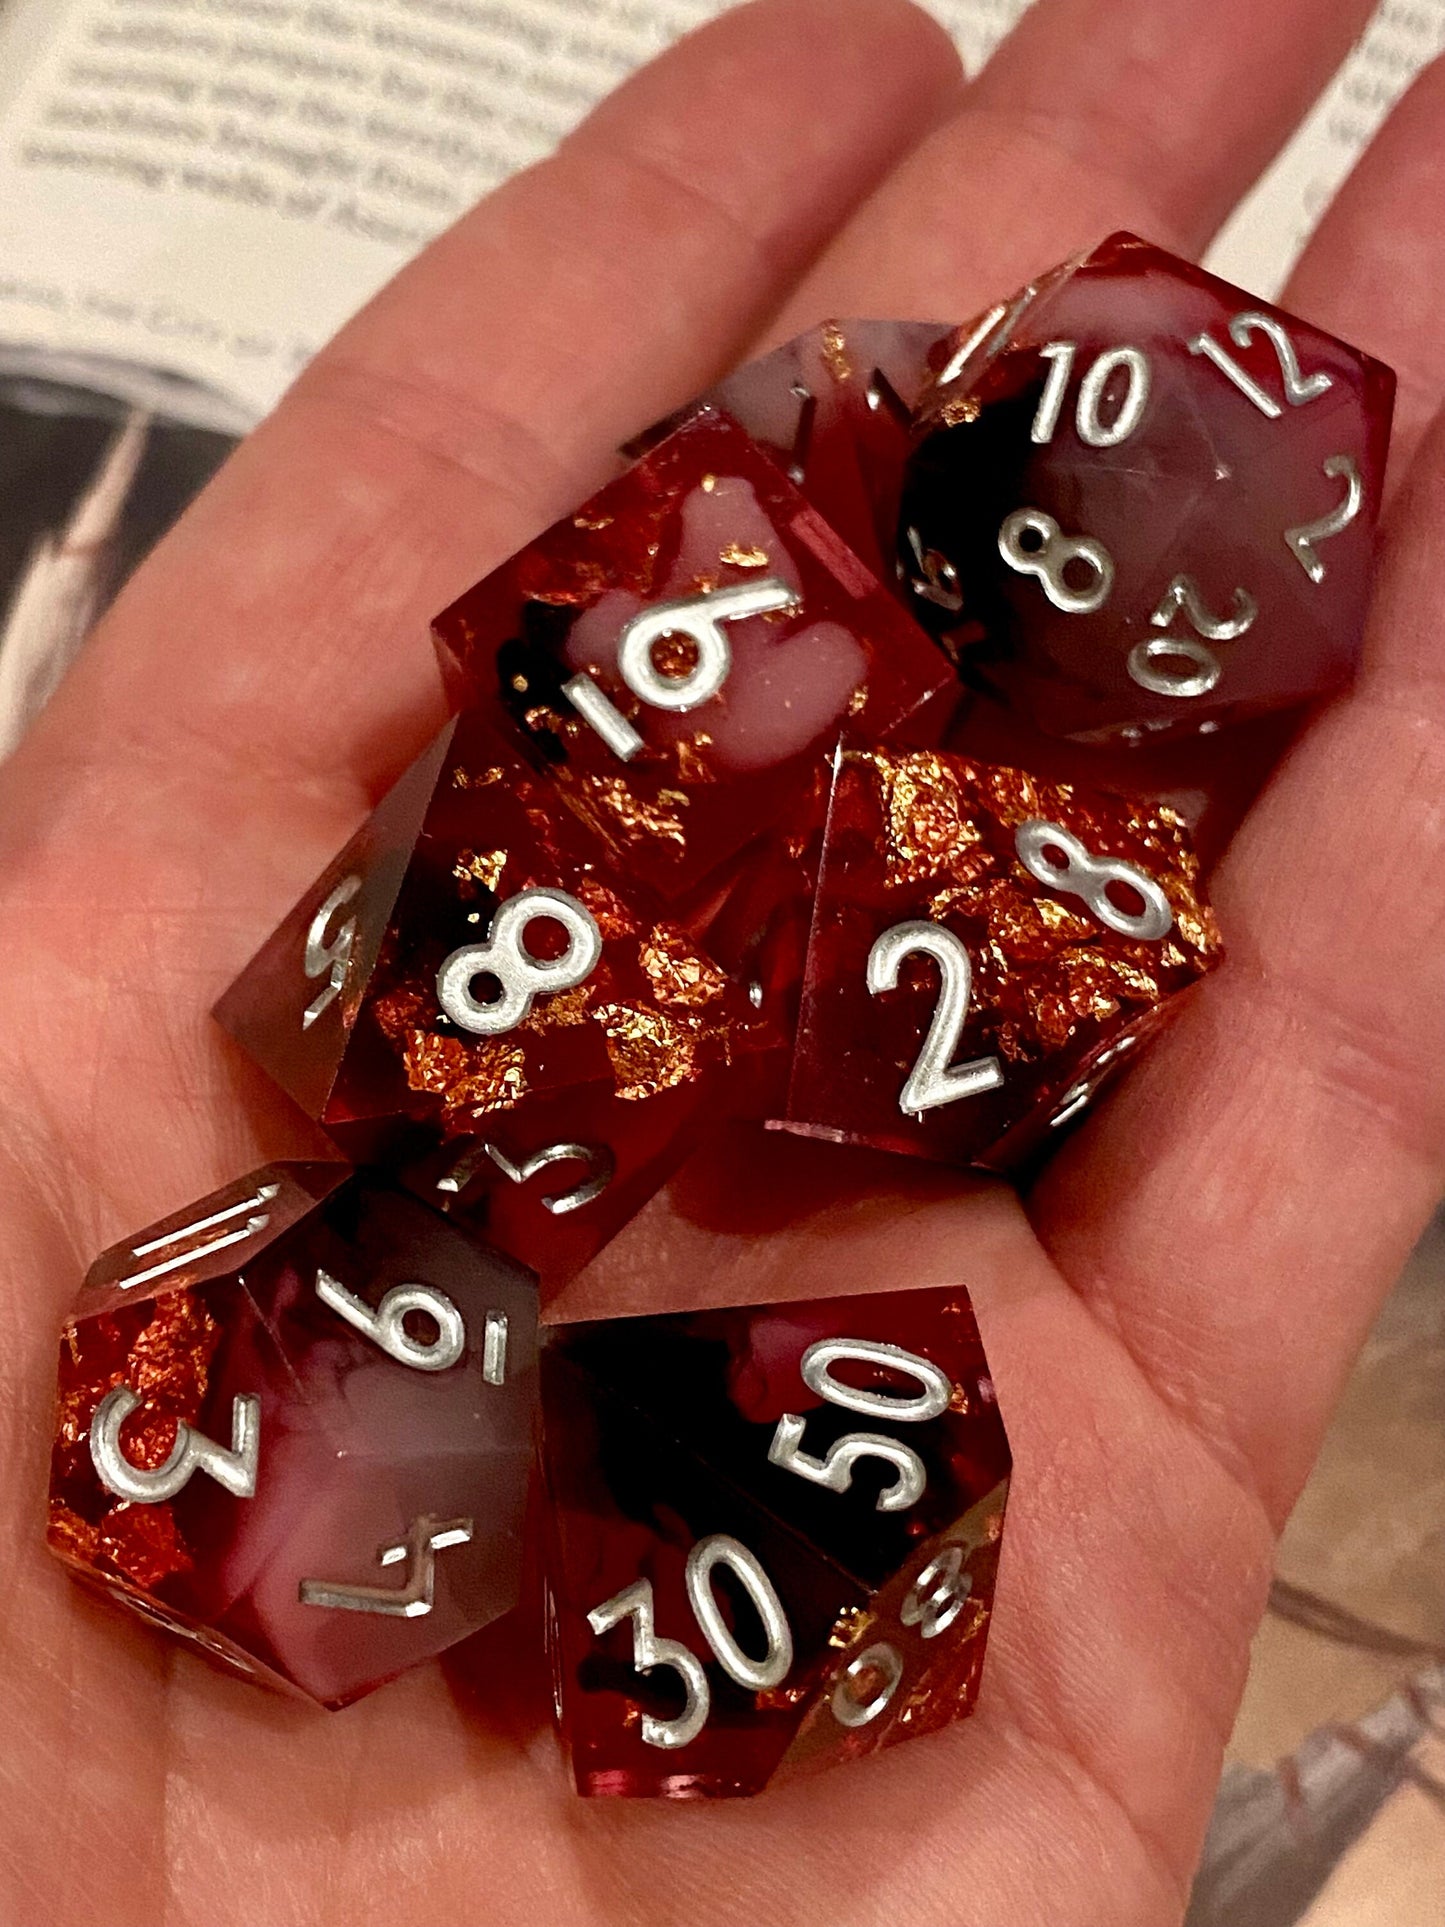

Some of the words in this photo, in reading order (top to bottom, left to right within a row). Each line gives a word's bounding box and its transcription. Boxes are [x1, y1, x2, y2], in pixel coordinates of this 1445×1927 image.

[1030, 340, 1150, 448] 10
[1188, 310, 1333, 418] 12
[998, 507, 1115, 614] 8
[1284, 455, 1362, 584] 2
[1127, 573, 1261, 698] 20
[1015, 819, 1174, 941] 8
[436, 886, 602, 1035] 8
[866, 919, 1005, 1117] 2
[117, 1183, 280, 1291] 11
[90, 1384, 261, 1503] 3
[767, 1336, 953, 1512] 50
[586, 1533, 794, 1750] 30
